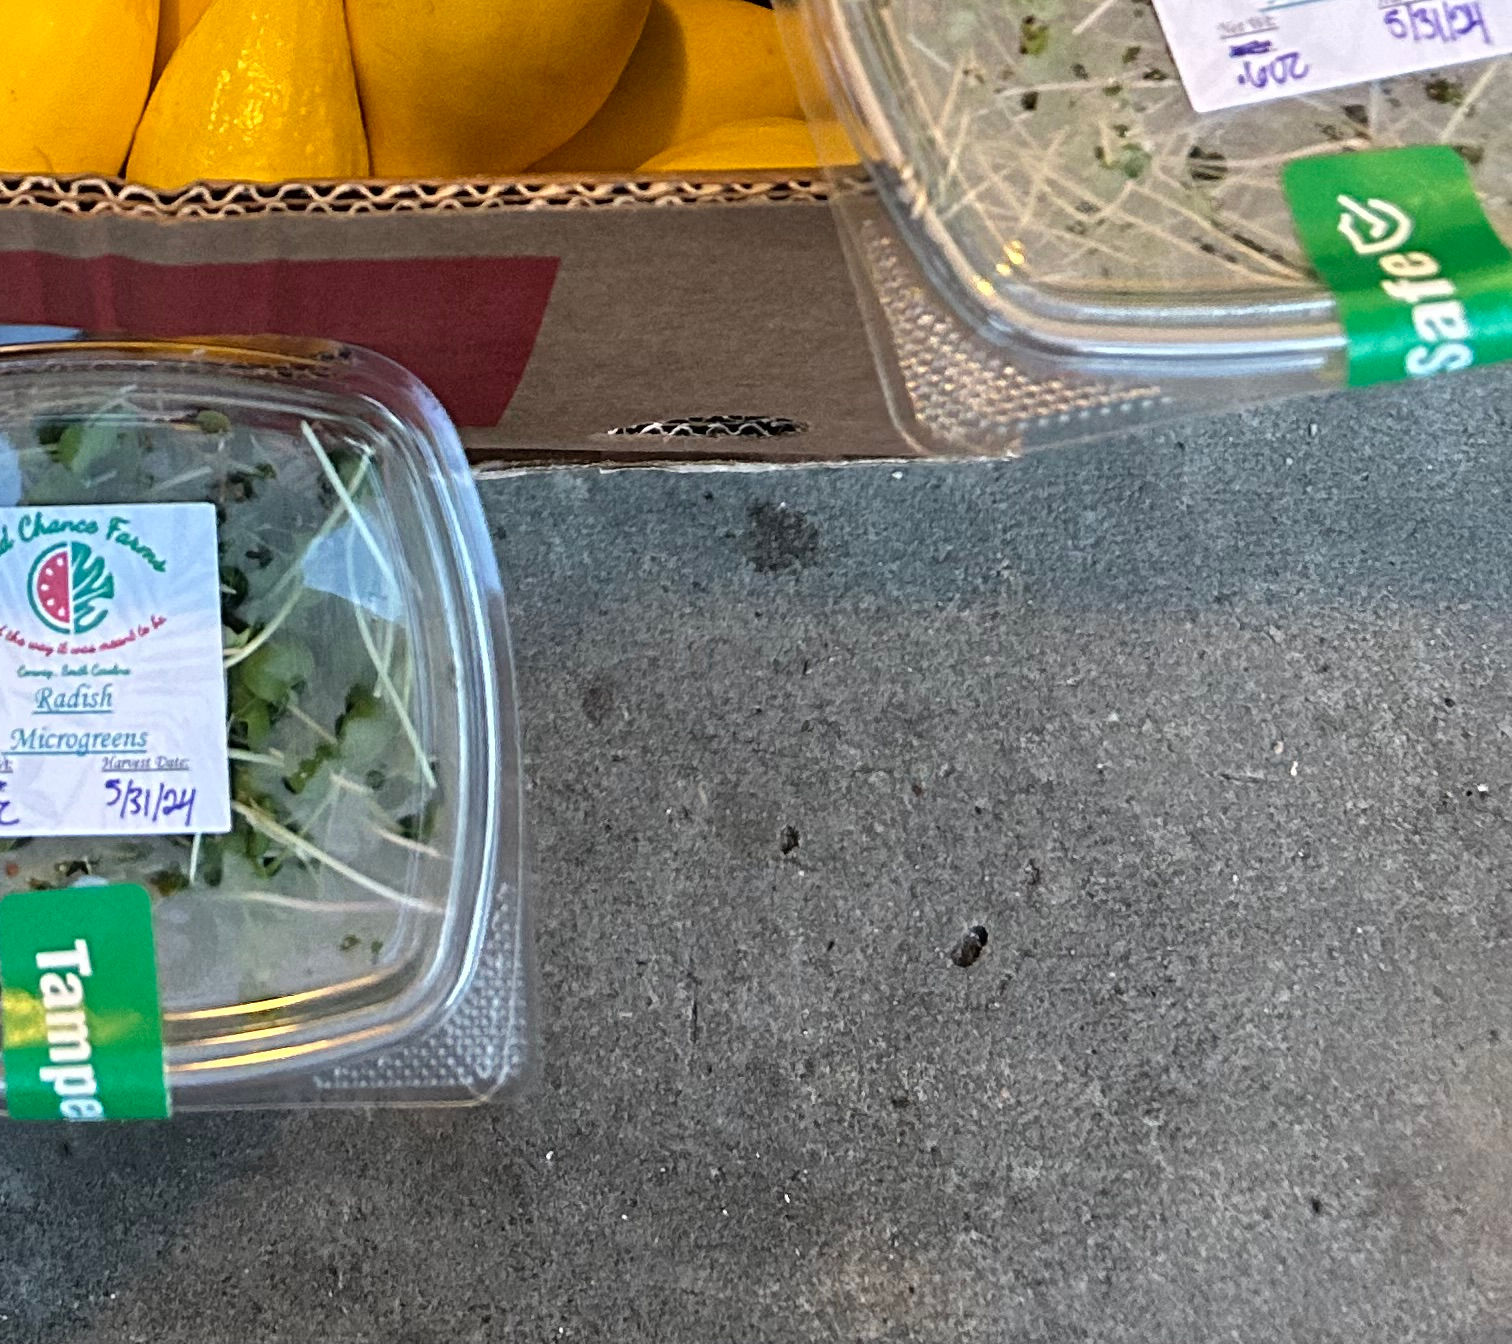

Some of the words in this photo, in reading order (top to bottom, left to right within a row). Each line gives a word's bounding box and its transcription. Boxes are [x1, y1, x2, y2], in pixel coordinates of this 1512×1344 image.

[1377, 250, 1474, 377] Safe
[18, 511, 99, 543] Chance
[106, 516, 167, 572] Farms
[5, 630, 26, 647] the
[34, 682, 113, 712] Radish
[9, 726, 148, 757] Microgreens
[102, 756, 151, 772] Harvest
[105, 778, 196, 826] 5/31/24
